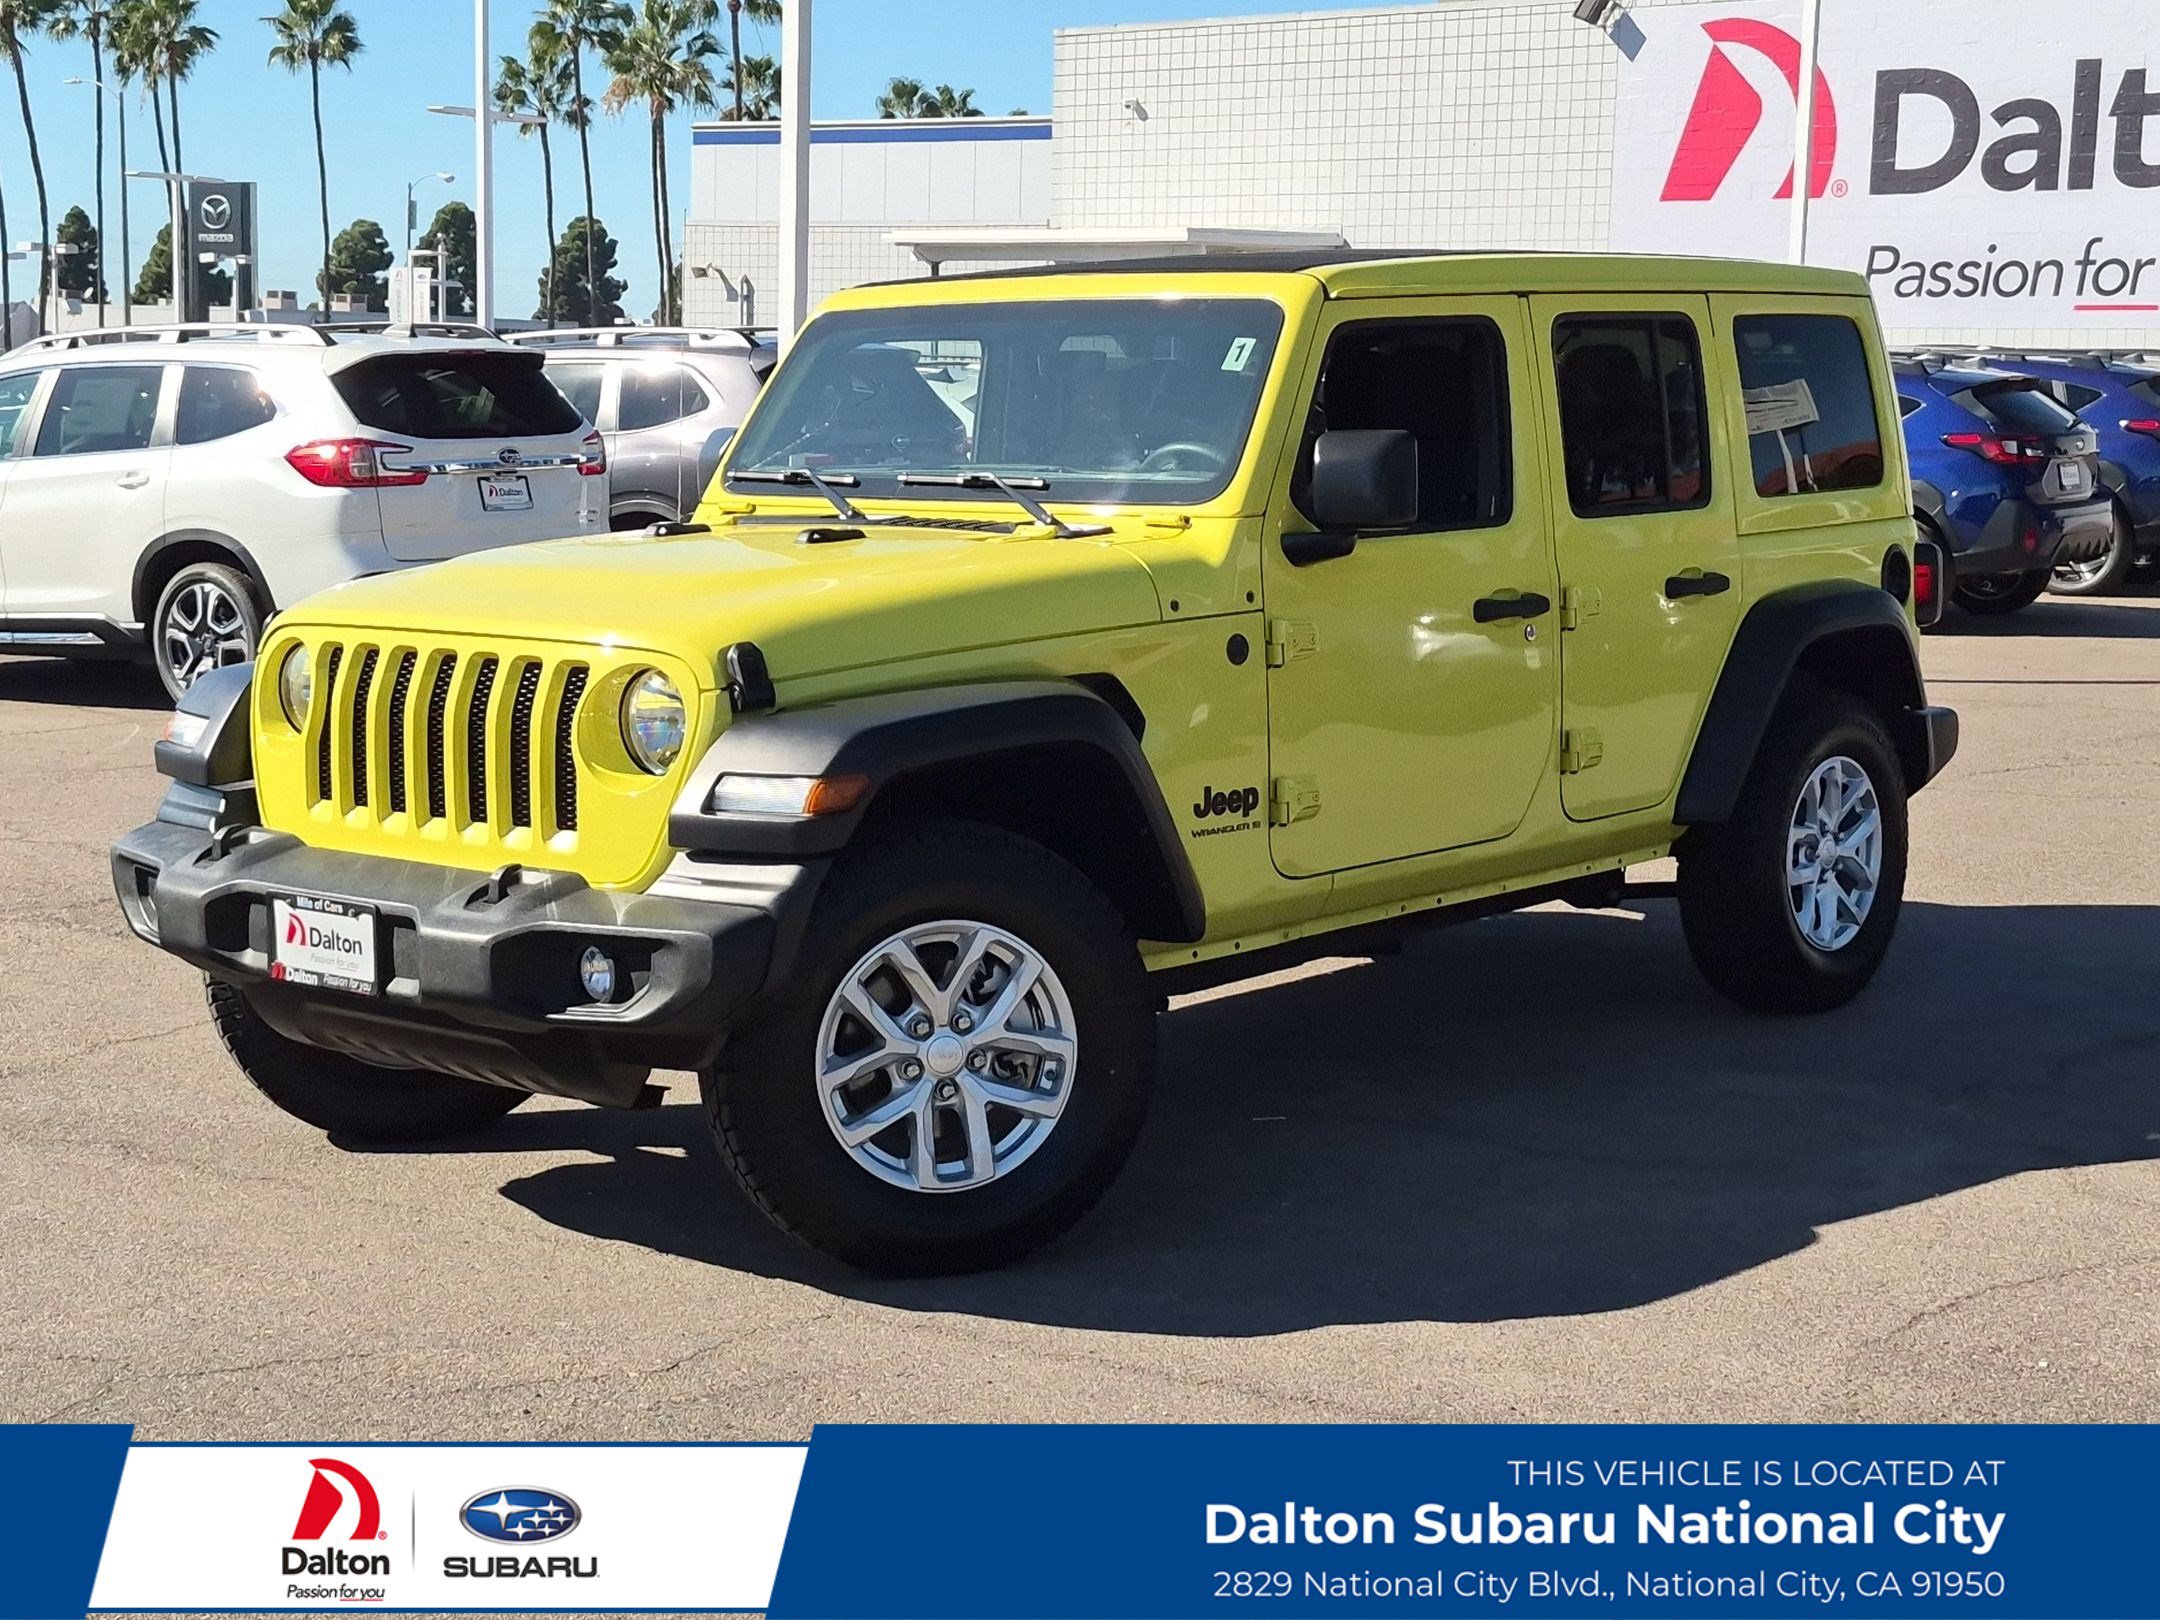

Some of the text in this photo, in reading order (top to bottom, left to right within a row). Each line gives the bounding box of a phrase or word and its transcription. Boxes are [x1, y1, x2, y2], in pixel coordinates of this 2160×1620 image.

[1866, 237, 2157, 298] Passion for
[1234, 342, 1247, 363] 1
[1193, 786, 1259, 819] Jeep
[1191, 822, 1250, 838] WRANGLER
[296, 896, 344, 914] Mile of Cars
[309, 926, 363, 955] Dalton
[285, 966, 372, 993] Dalton Passion for you
